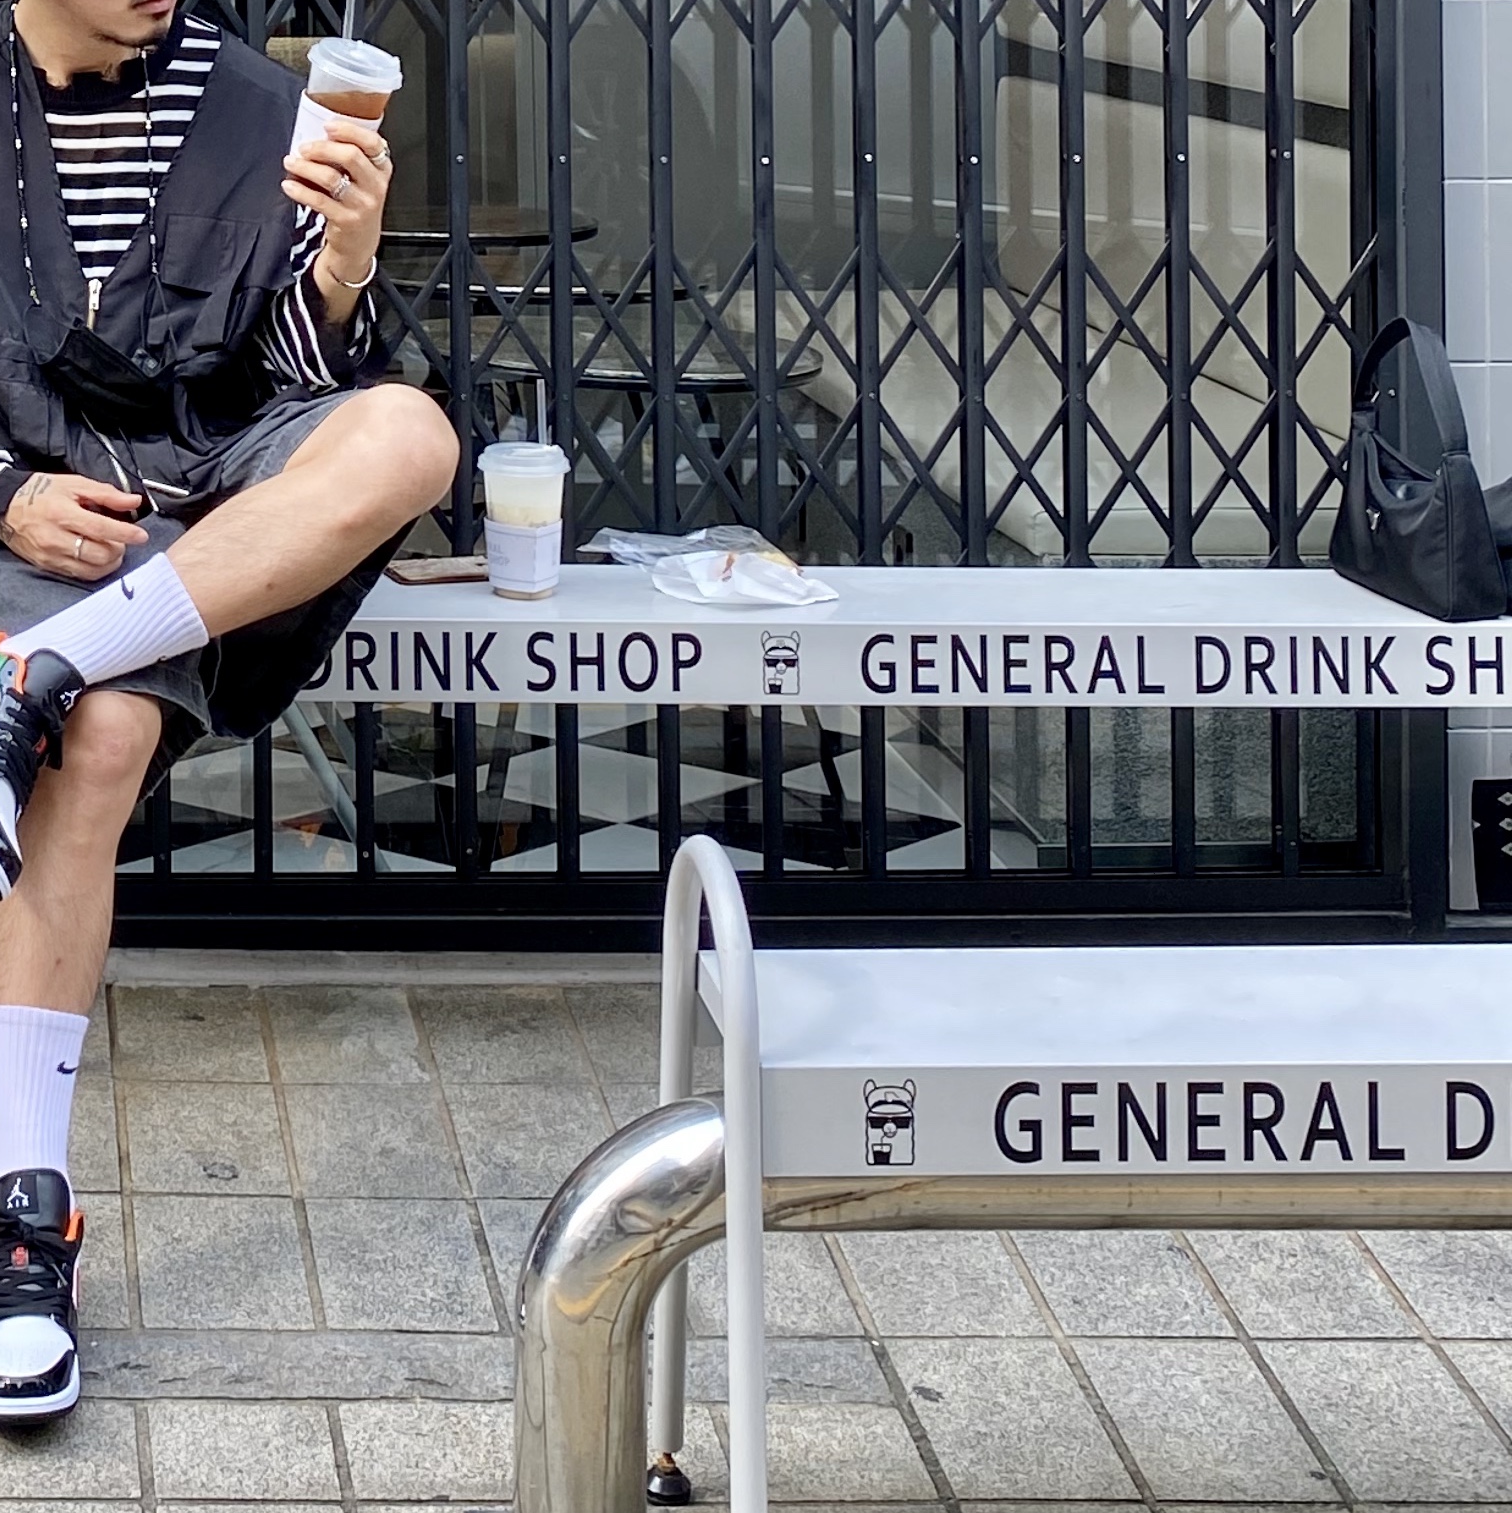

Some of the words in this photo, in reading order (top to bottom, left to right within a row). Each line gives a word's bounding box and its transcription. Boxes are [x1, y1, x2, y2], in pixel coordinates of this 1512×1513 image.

[526, 631, 702, 693] SHOP
[861, 633, 1166, 694] GENERAL
[1194, 635, 1399, 695] DRINK
[1425, 635, 1504, 696] SH
[994, 1081, 1406, 1164] GENERAL
[1445, 1081, 1496, 1162] D
